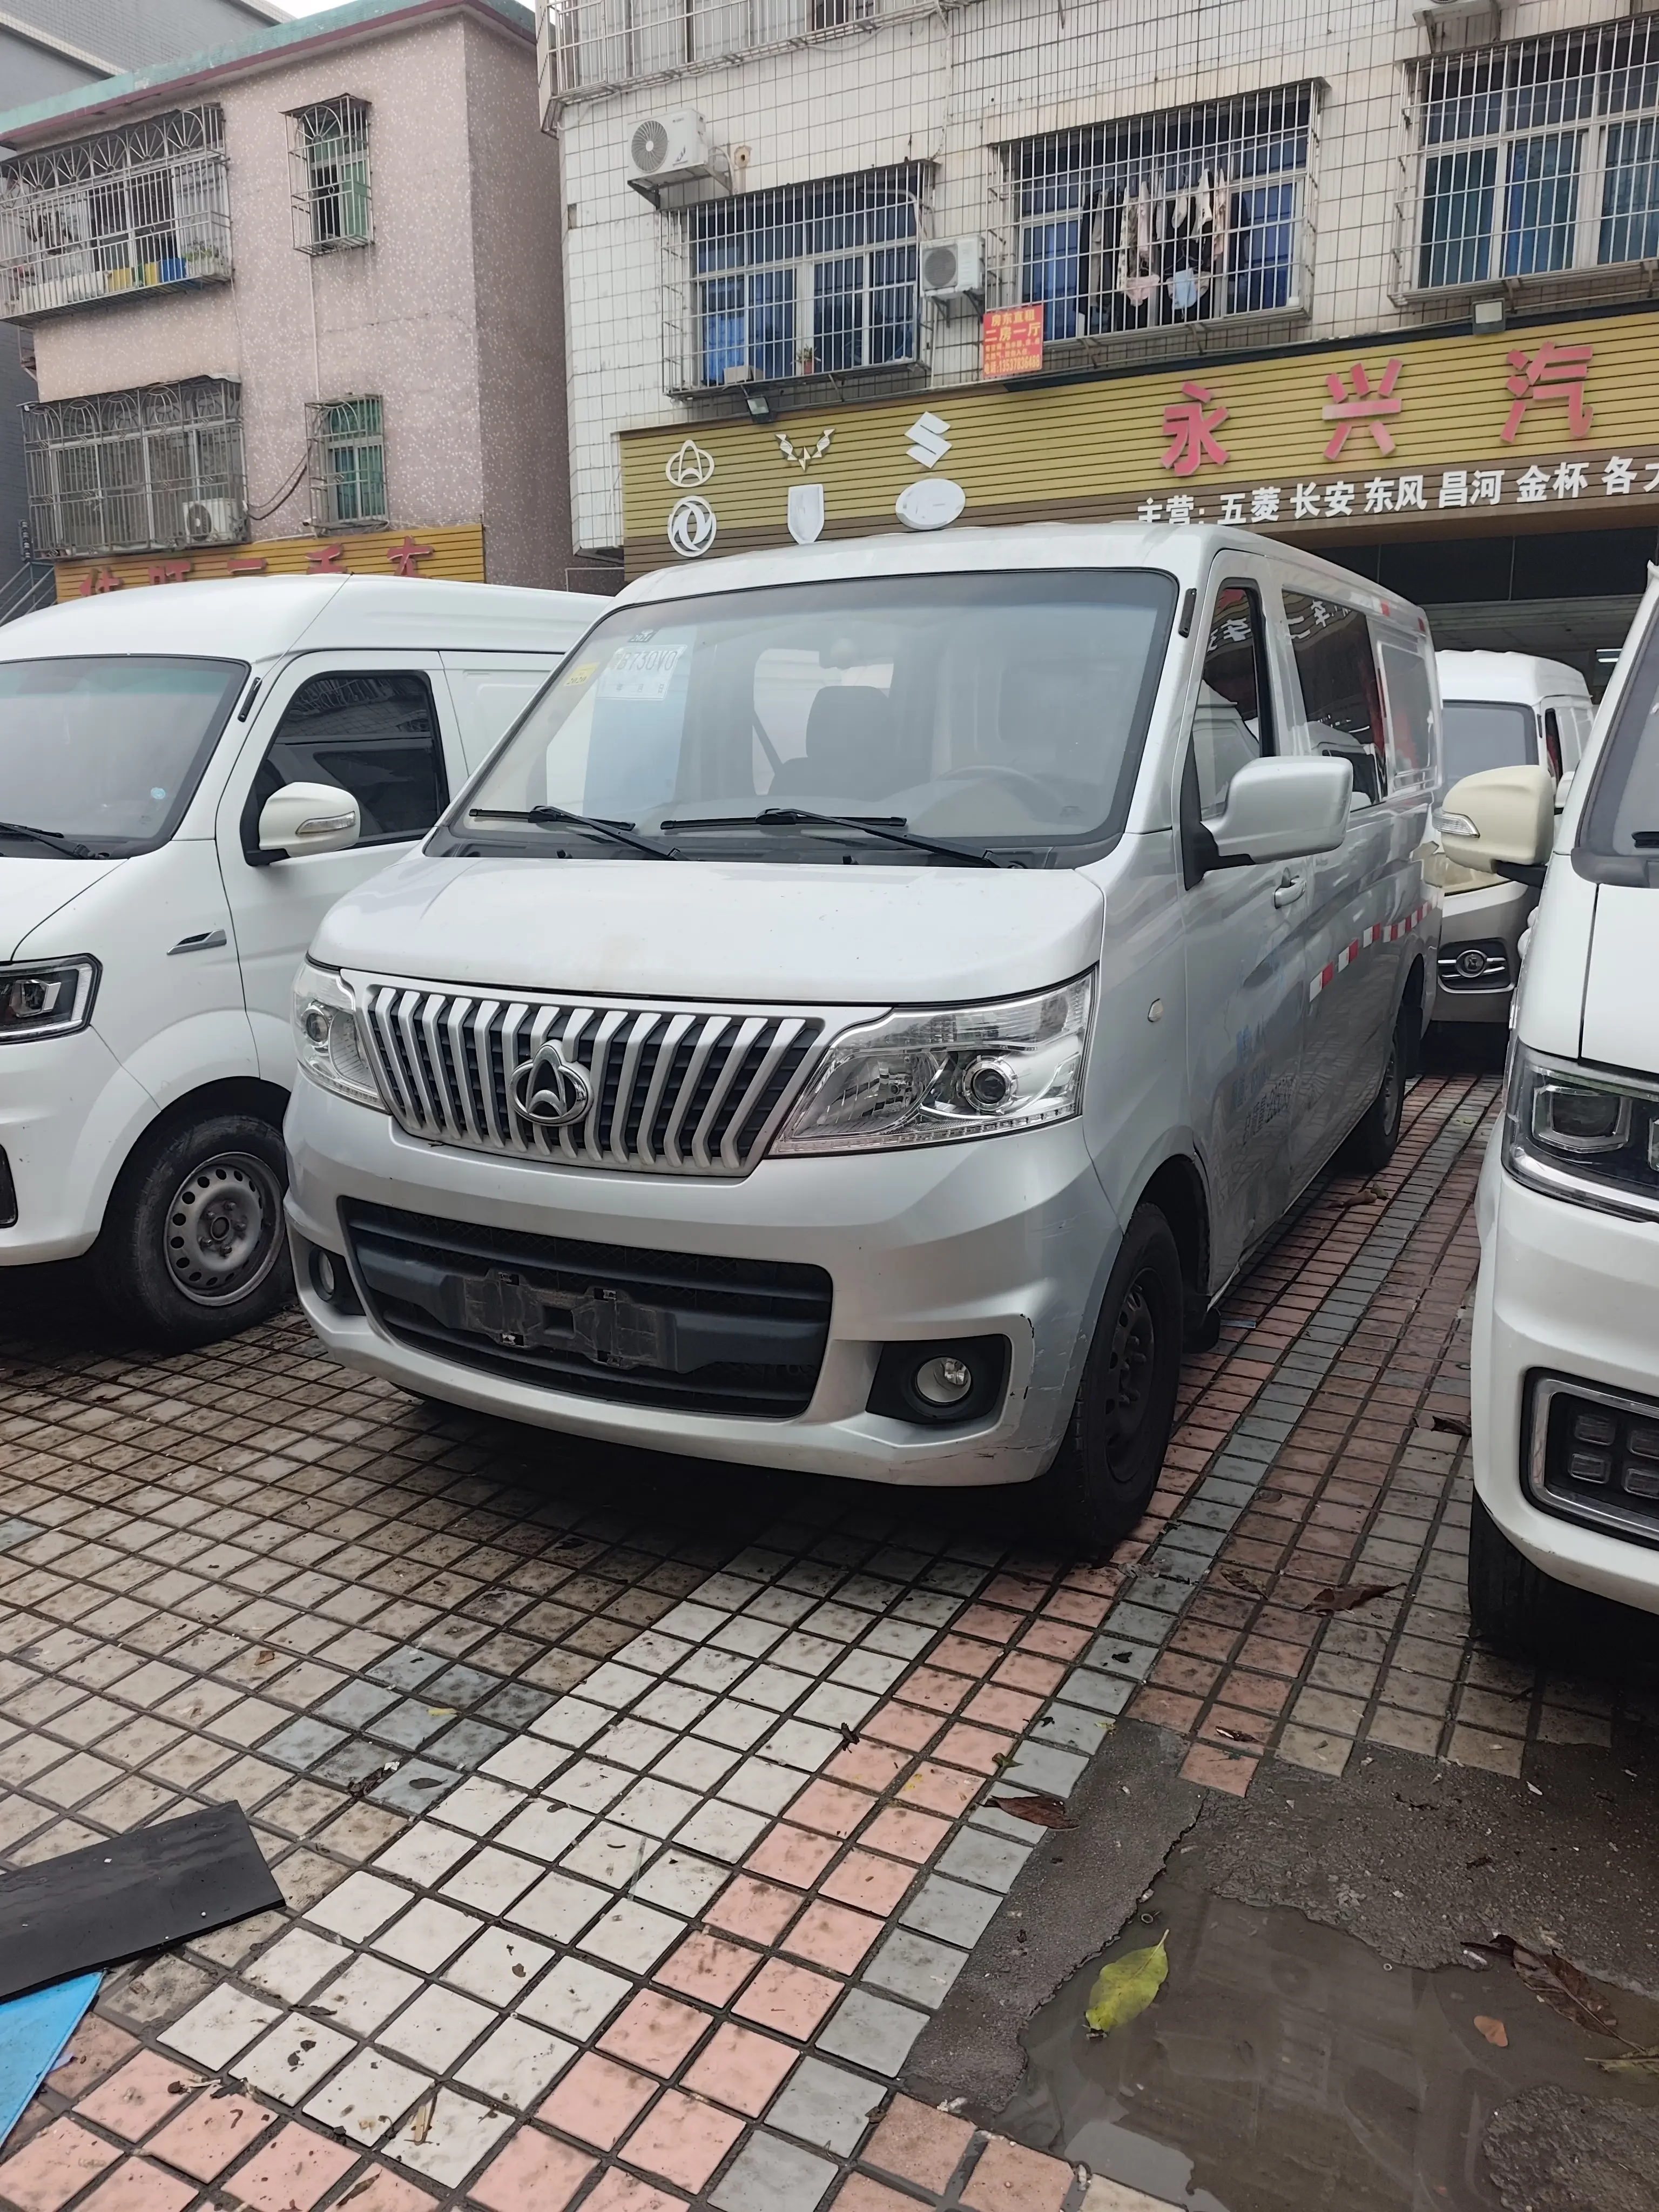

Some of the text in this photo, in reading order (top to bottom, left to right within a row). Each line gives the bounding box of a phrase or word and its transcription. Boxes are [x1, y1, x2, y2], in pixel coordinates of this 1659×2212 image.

[992, 309, 1035, 327] 房东直租
[984, 322, 1041, 342] 二房一厅
[1217, 486, 1282, 525] 五菱
[1290, 481, 1355, 520] 长安
[1364, 475, 1428, 514] 东风
[1439, 470, 1506, 509] 昌河
[1516, 462, 1590, 503] 金杯
